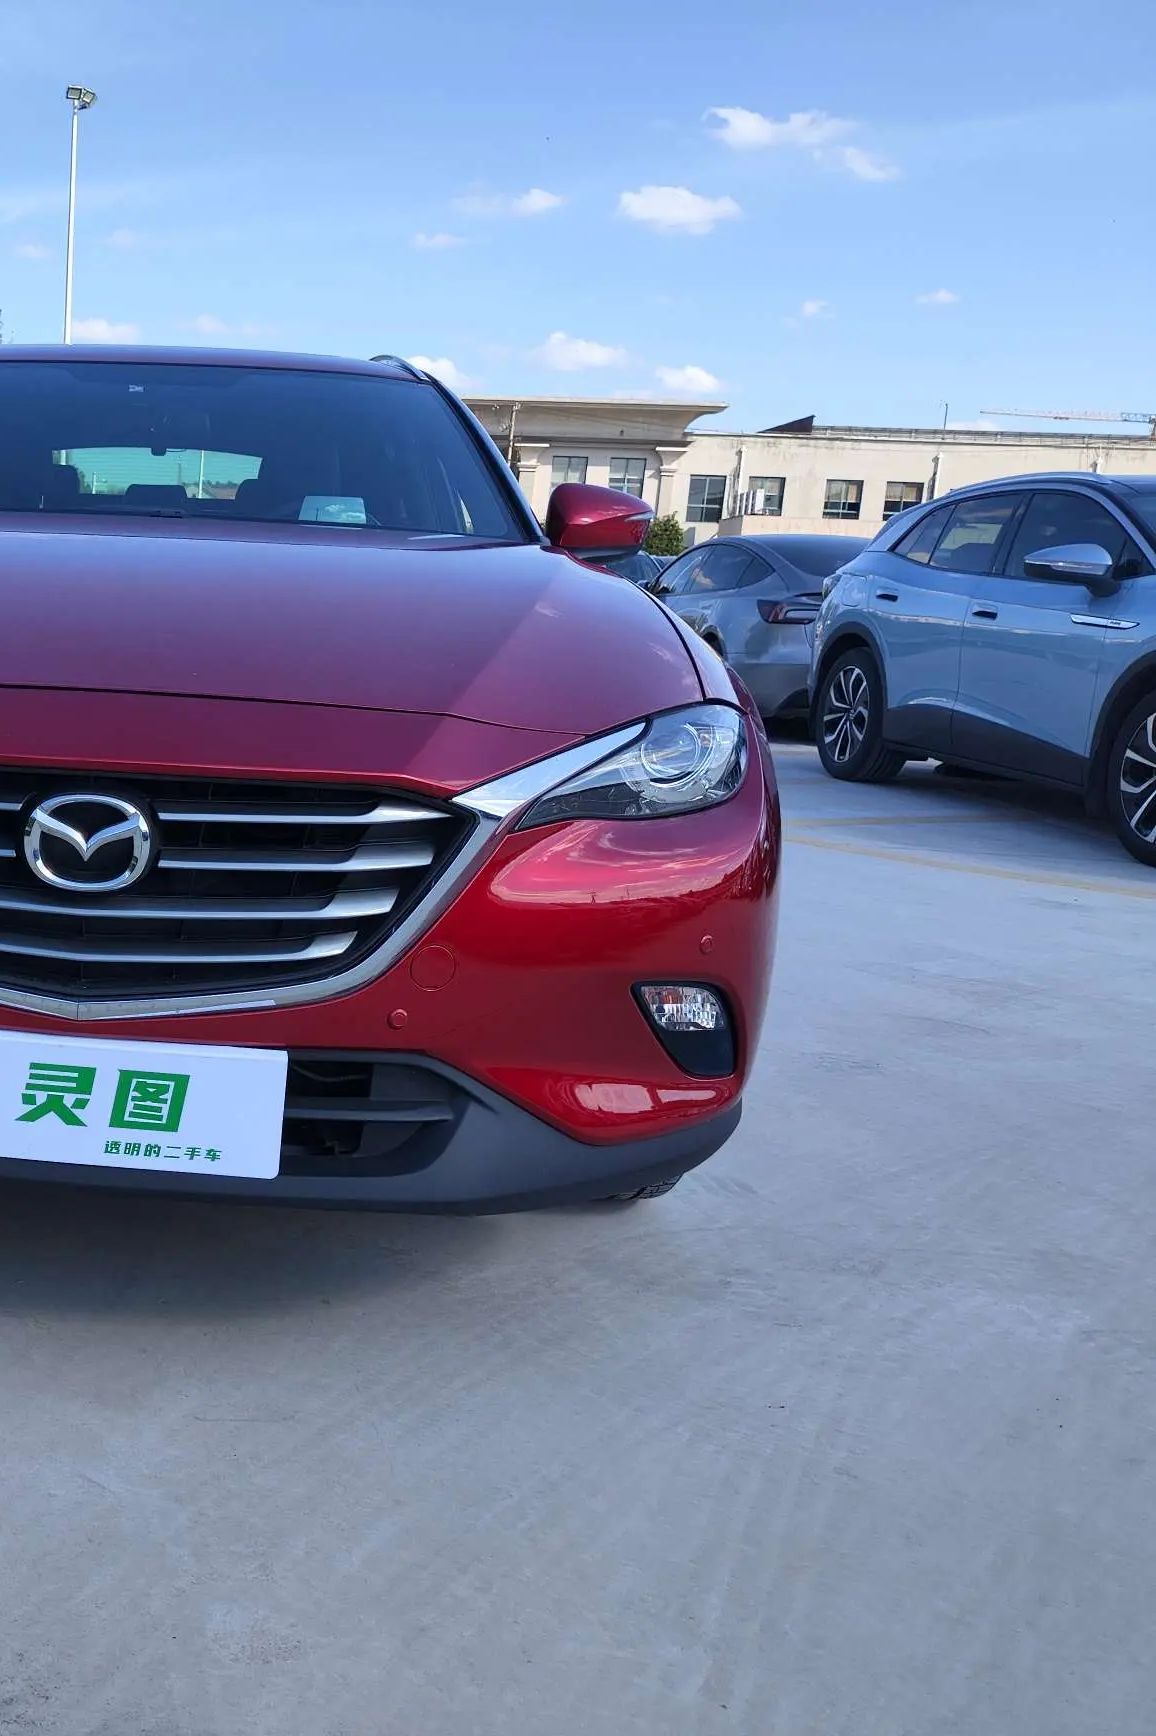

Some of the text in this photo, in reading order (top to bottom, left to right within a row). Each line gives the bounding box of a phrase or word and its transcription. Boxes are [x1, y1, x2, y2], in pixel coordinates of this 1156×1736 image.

[14, 1062, 191, 1133] 灵图
[103, 1140, 222, 1162] 透明的二手车
